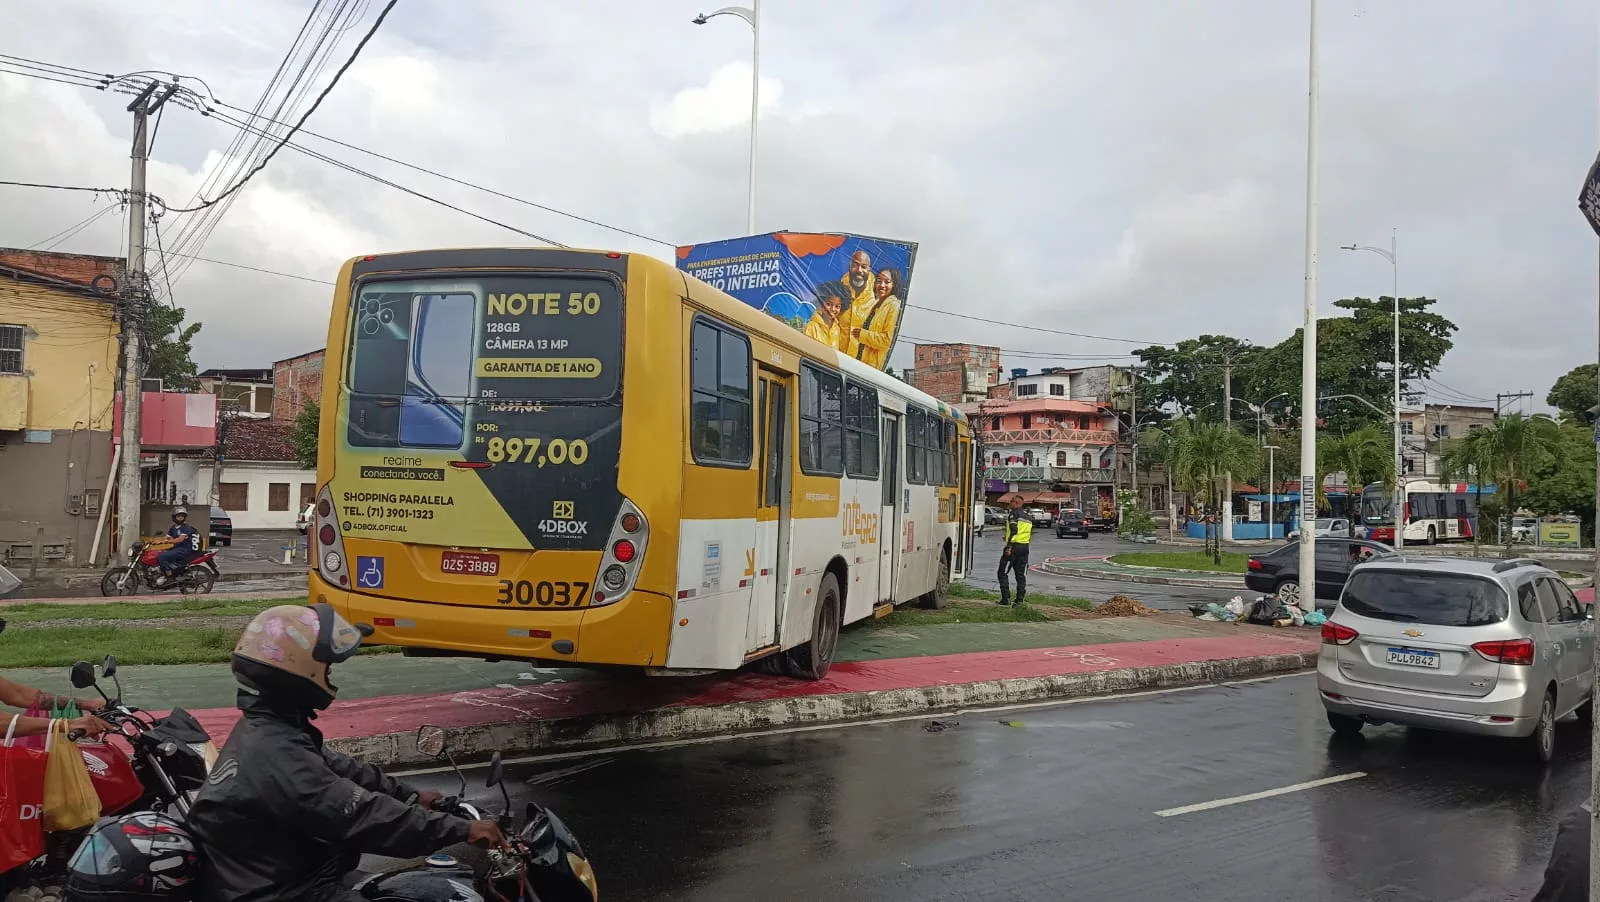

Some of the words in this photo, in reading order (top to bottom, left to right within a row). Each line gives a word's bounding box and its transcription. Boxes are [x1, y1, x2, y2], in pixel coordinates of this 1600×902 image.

[696, 267, 724, 280] PREFS
[726, 259, 780, 276] TRABALHA
[727, 272, 783, 291] INTEIRO.
[487, 292, 560, 315] NOTE
[567, 292, 601, 315] 50
[486, 322, 521, 333] 128GB
[485, 336, 535, 350] CÂMERA
[537, 339, 548, 350] 13
[550, 340, 568, 350] MP
[484, 362, 543, 373] GARANTIA
[544, 363, 560, 373] DE
[569, 363, 595, 373] ANO
[482, 390, 497, 398] DE:
[476, 424, 499, 432] POR:
[487, 436, 589, 468] 897,00
[383, 456, 422, 466] realme
[363, 469, 416, 479] conectando
[418, 470, 442, 480] você.
[343, 492, 397, 503] SHOPPING
[399, 494, 454, 506] PARALELA
[343, 506, 365, 516] TEL.
[367, 505, 384, 518] (71)
[386, 508, 434, 519] 3901-1323
[537, 519, 588, 534] 4DBOX
[496, 579, 590, 607] 30037
[1391, 653, 1434, 666] PLL9B42
